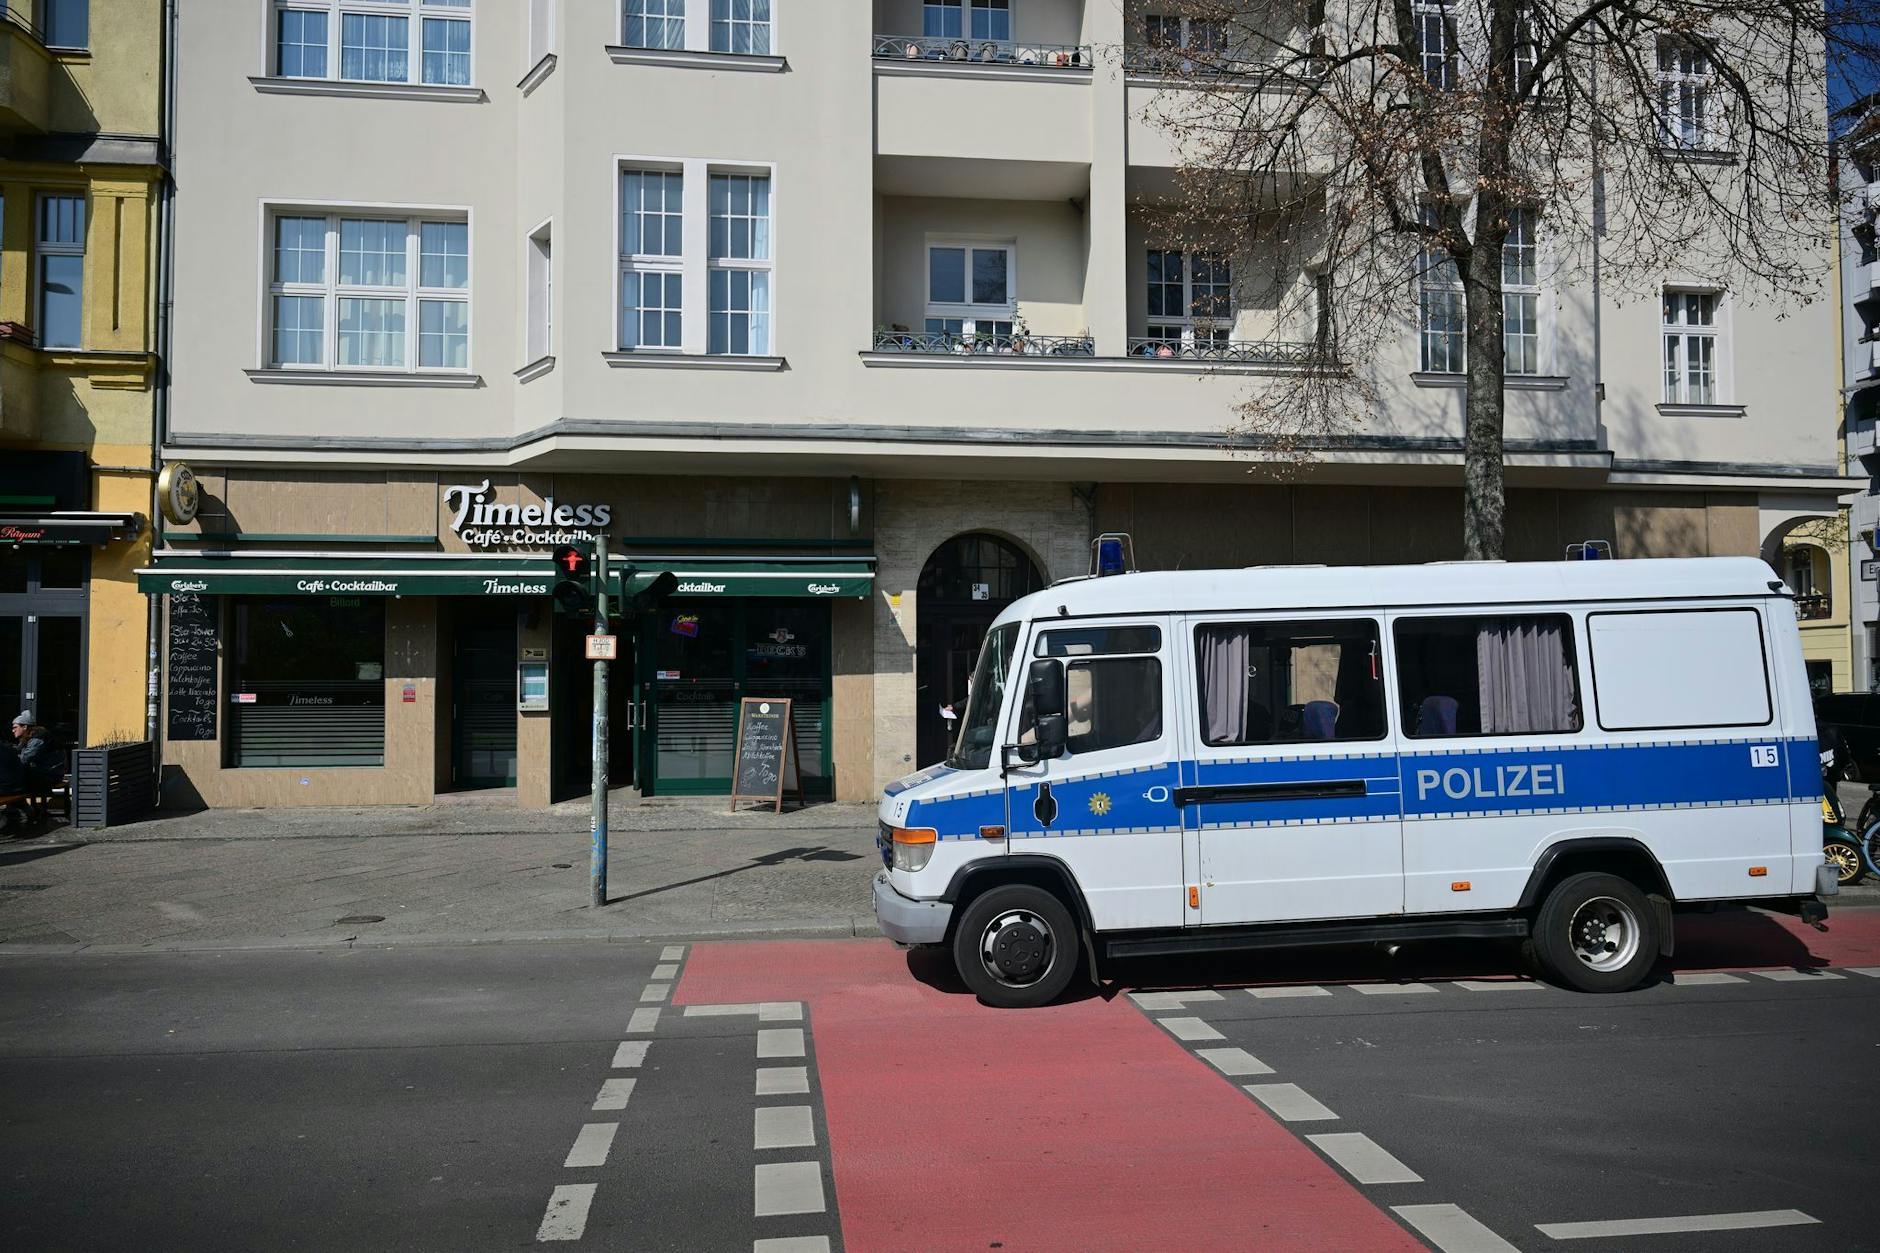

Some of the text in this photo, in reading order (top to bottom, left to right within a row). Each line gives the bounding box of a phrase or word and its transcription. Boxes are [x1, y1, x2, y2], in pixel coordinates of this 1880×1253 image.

[444, 479, 611, 532] Timeless
[462, 529, 610, 547] Café Cocktailb
[171, 580, 208, 592] Carlsberg
[297, 580, 398, 593] Café Cocktailbar
[483, 578, 547, 594] Timeless
[677, 582, 726, 593] cktailbar
[807, 583, 841, 595] Carlsberg
[288, 695, 334, 706] Timeless
[1754, 748, 1776, 765] 15
[1416, 764, 1565, 801] POLIZEI
[893, 802, 904, 818] 15
